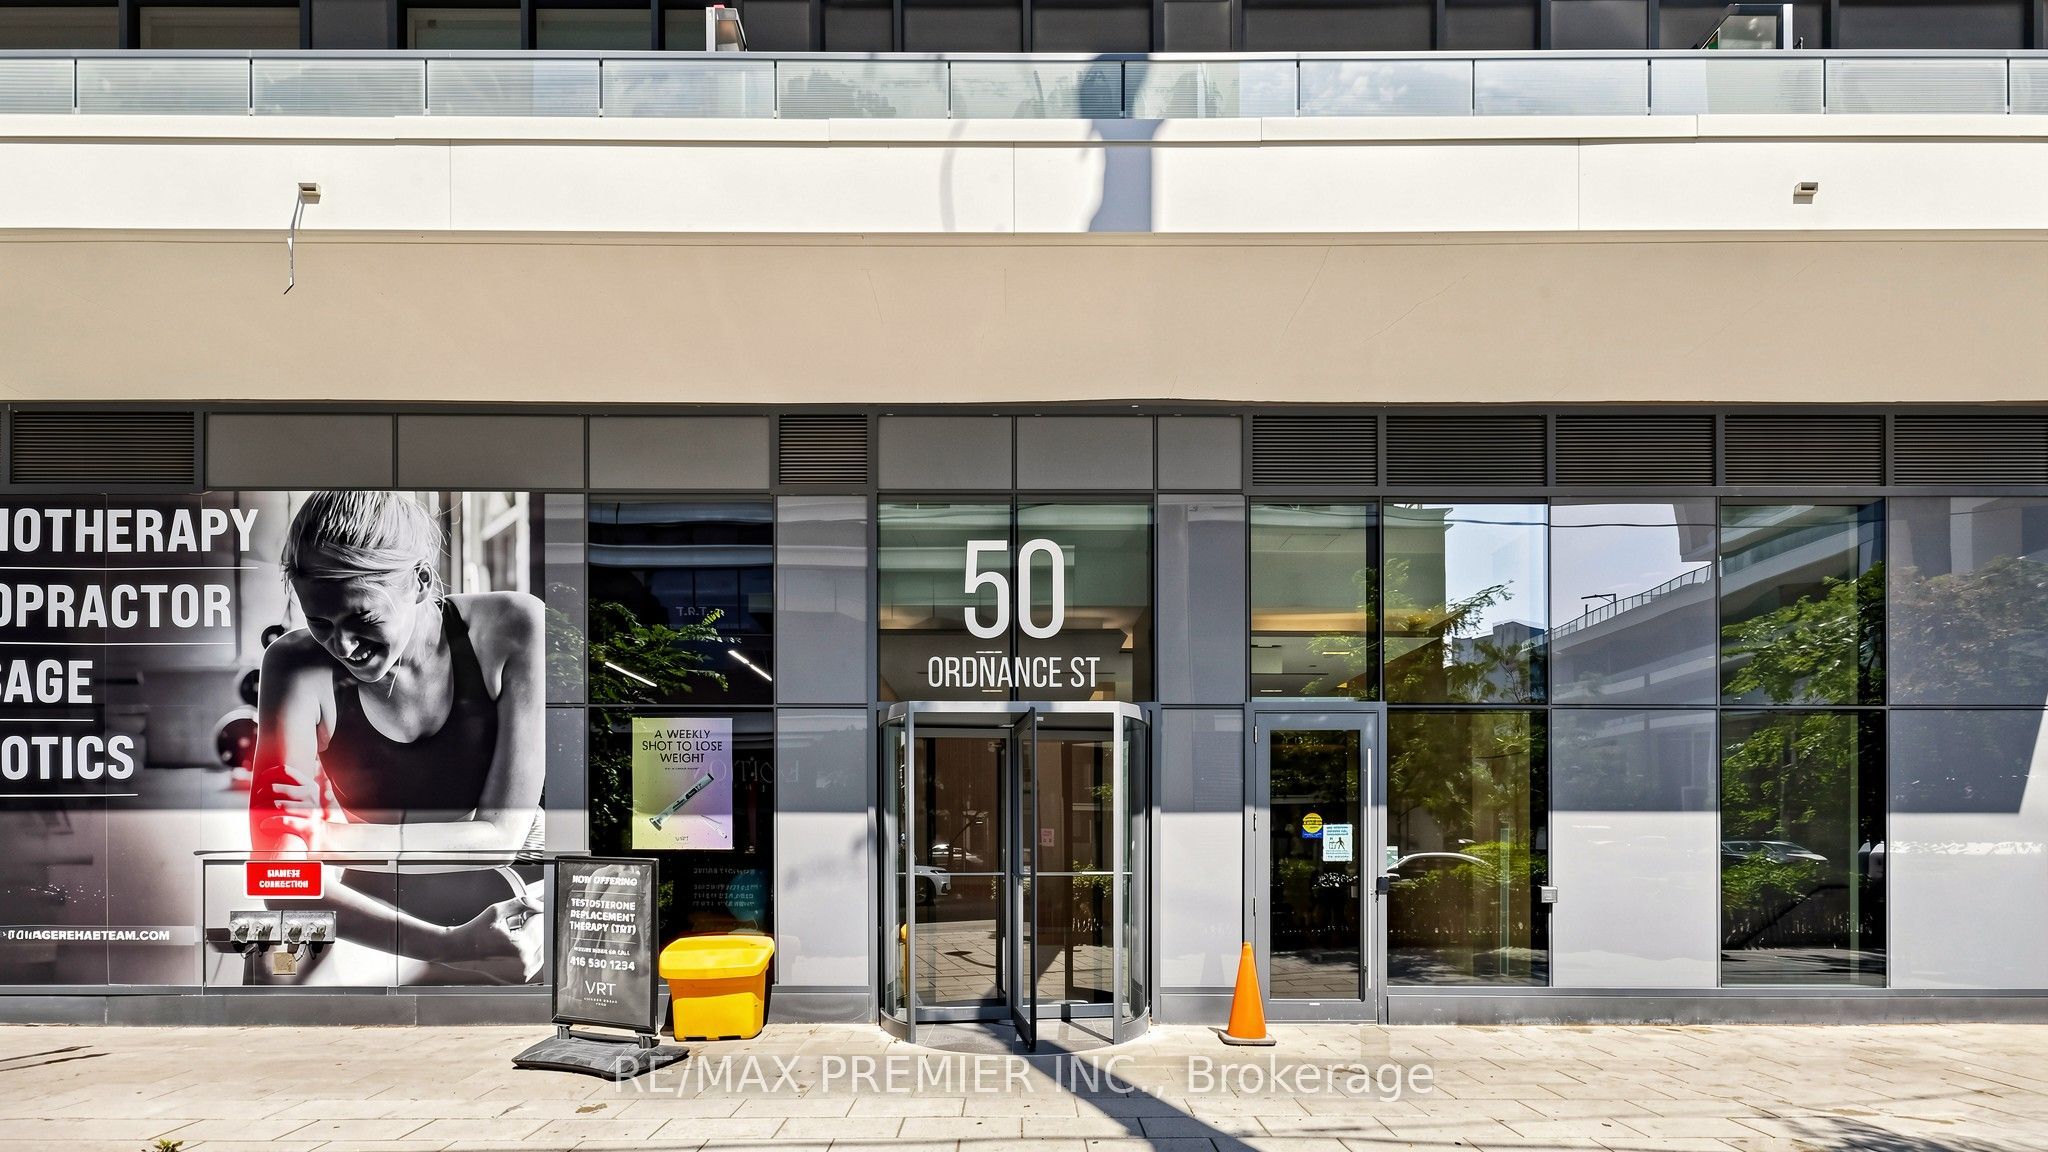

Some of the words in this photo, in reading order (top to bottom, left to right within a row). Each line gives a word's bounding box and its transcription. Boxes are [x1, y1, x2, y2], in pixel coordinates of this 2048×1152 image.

[964, 538, 1065, 640] 50
[928, 656, 1063, 688] ORDNANCE
[1070, 656, 1101, 688] ST
[0, 659, 94, 704] AGE
[654, 729, 663, 739] A
[666, 729, 711, 739] WEEKLY
[642, 740, 673, 751] SHOT
[676, 740, 692, 751] TO
[696, 740, 723, 751] LOSE
[1, 735, 134, 780] OTICS
[659, 753, 705, 763] WEIGHT
[571, 898, 637, 911] TESTOSTERONE
[570, 910, 636, 923] REPLACEMENT
[569, 921, 609, 932] THERAPY
[569, 956, 586, 967] 416
[588, 958, 607, 969] 530
[610, 960, 636, 971] 1234
[585, 980, 617, 996] VRT
